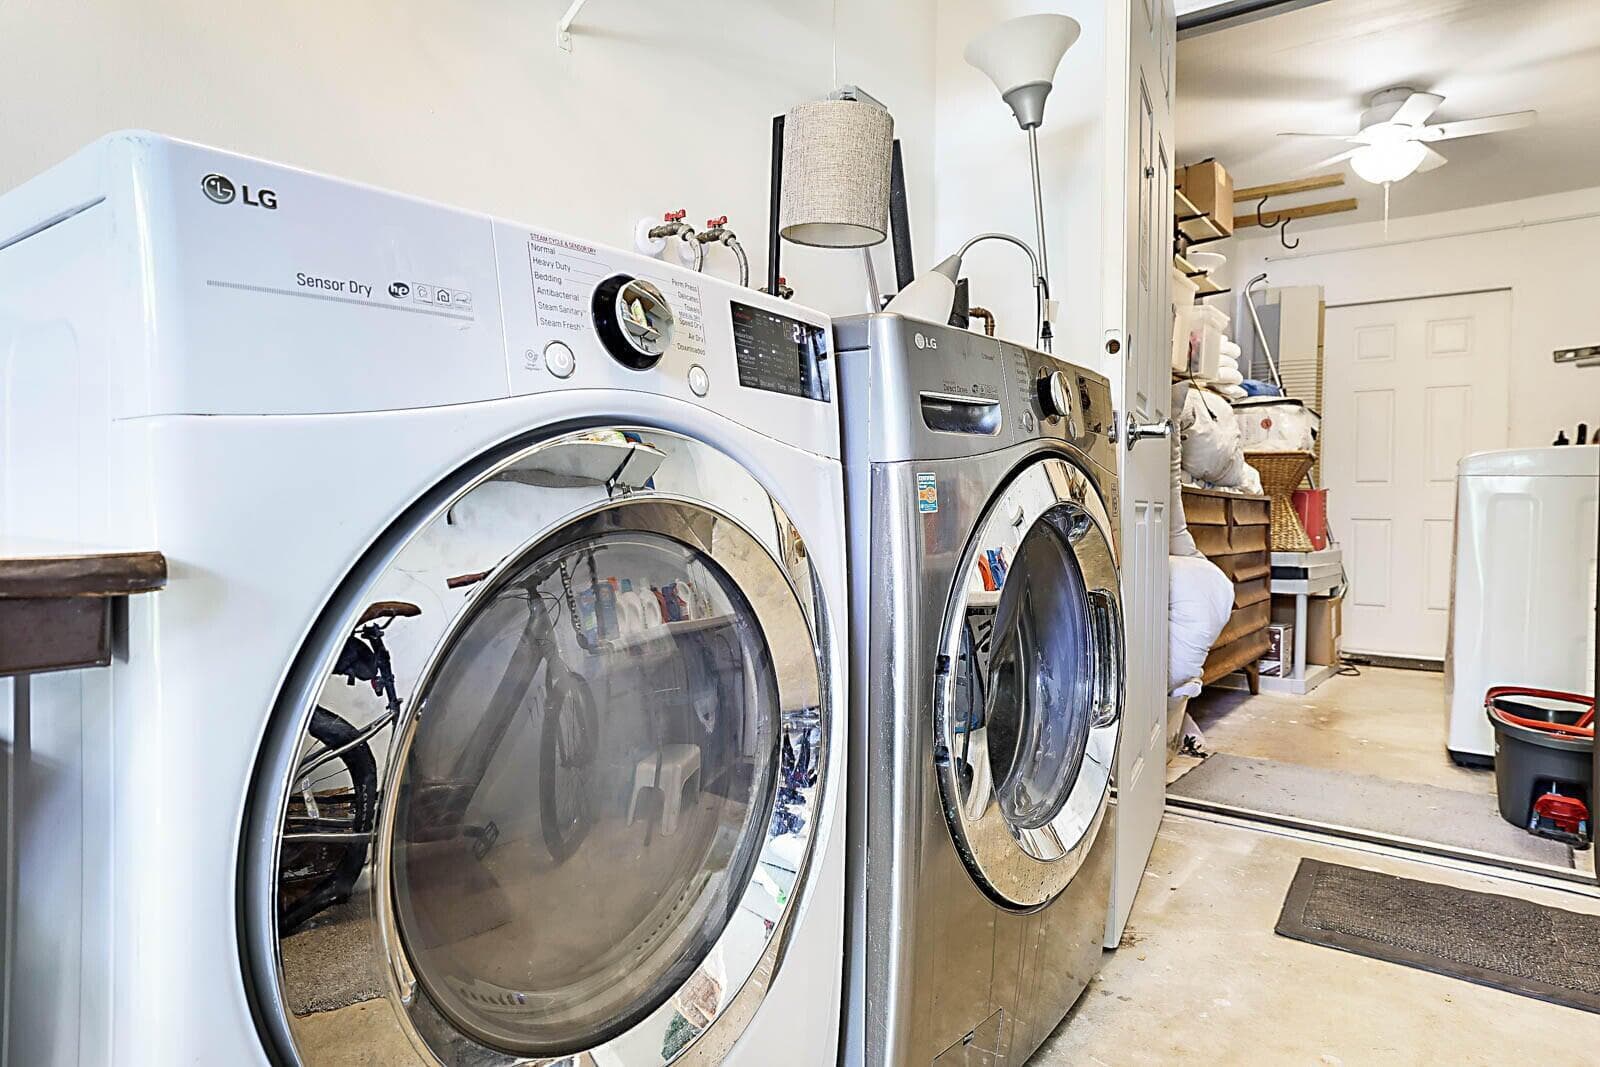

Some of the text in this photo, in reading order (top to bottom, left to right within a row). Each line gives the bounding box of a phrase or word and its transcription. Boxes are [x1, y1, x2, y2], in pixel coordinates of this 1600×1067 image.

[242, 184, 278, 210] LG
[531, 243, 556, 255] Normal
[532, 256, 571, 272] Heavy Duty
[295, 271, 372, 299] Sensor Dry
[534, 271, 562, 285] Bedding
[537, 287, 580, 301] Antibacterial
[538, 301, 559, 312] Steam
[540, 317, 561, 328] Steam
[925, 336, 937, 349] LG
